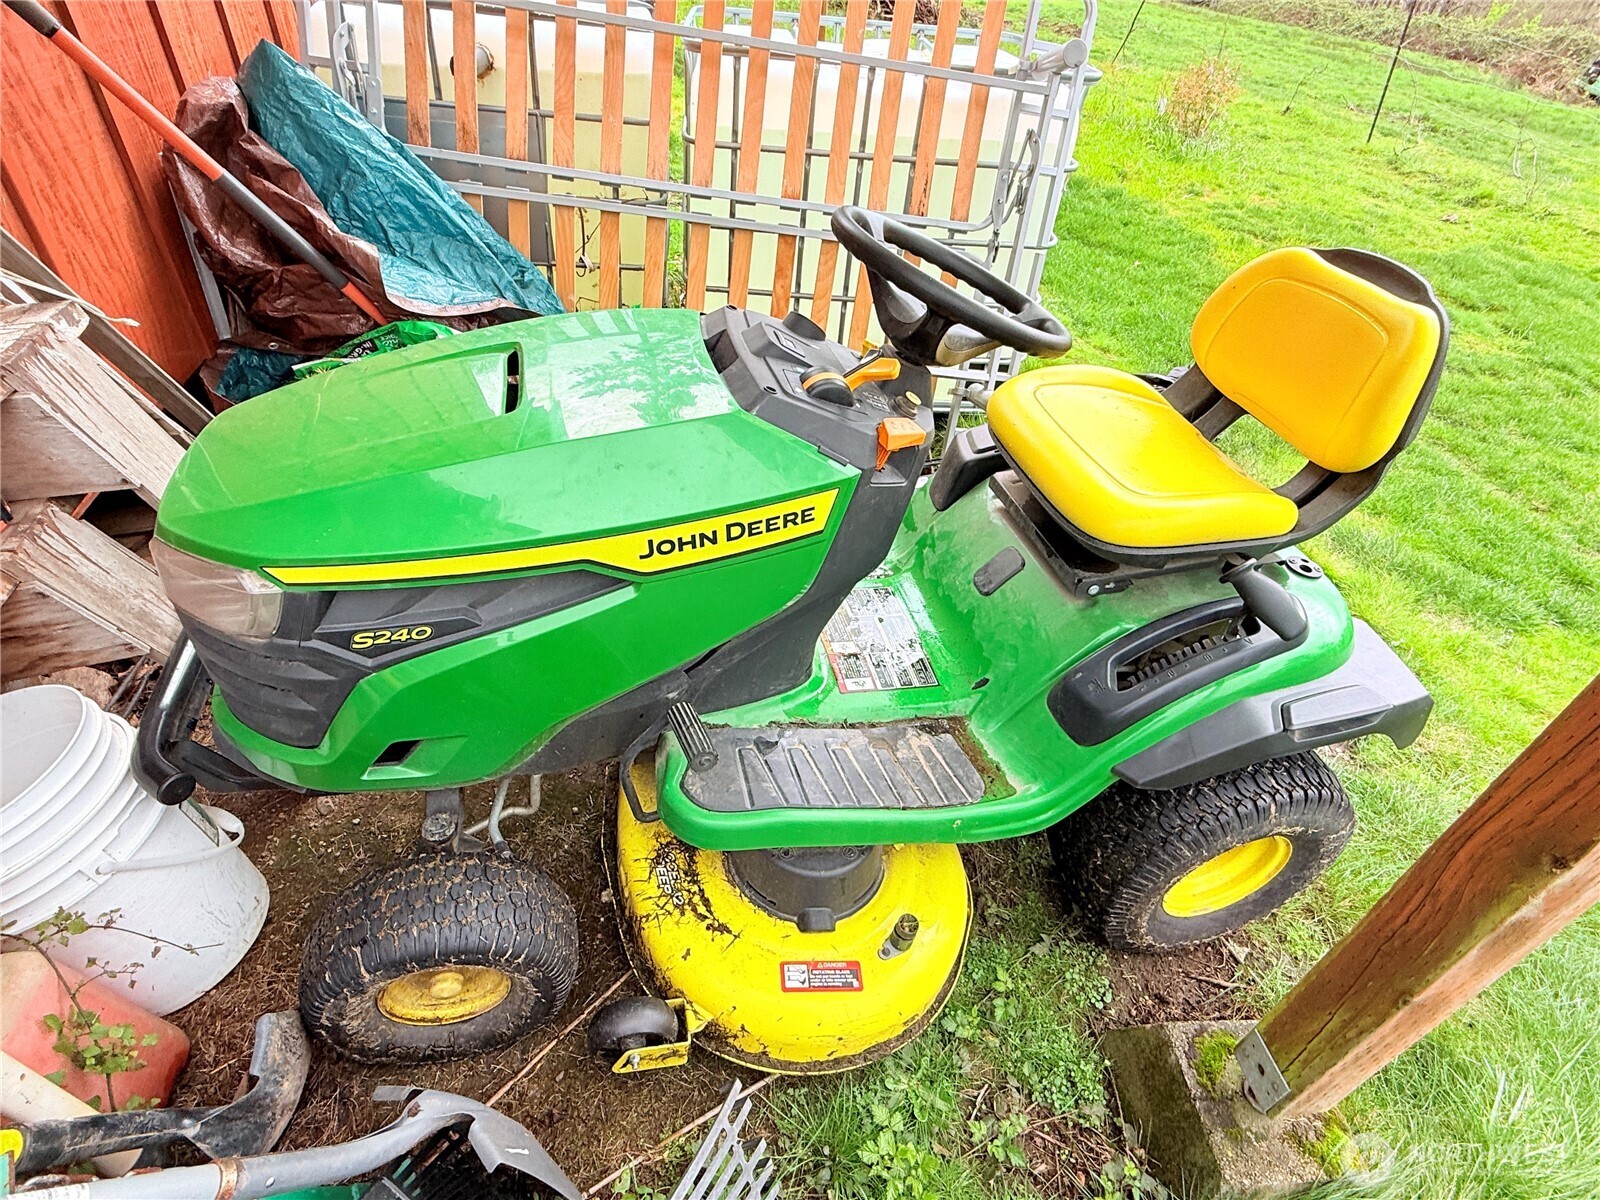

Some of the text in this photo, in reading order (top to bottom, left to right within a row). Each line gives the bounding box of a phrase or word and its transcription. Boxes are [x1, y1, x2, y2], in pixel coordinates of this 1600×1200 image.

[639, 507, 815, 560] JOHN DEERE
[351, 626, 433, 649] S240
[655, 860, 672, 894] EEP
